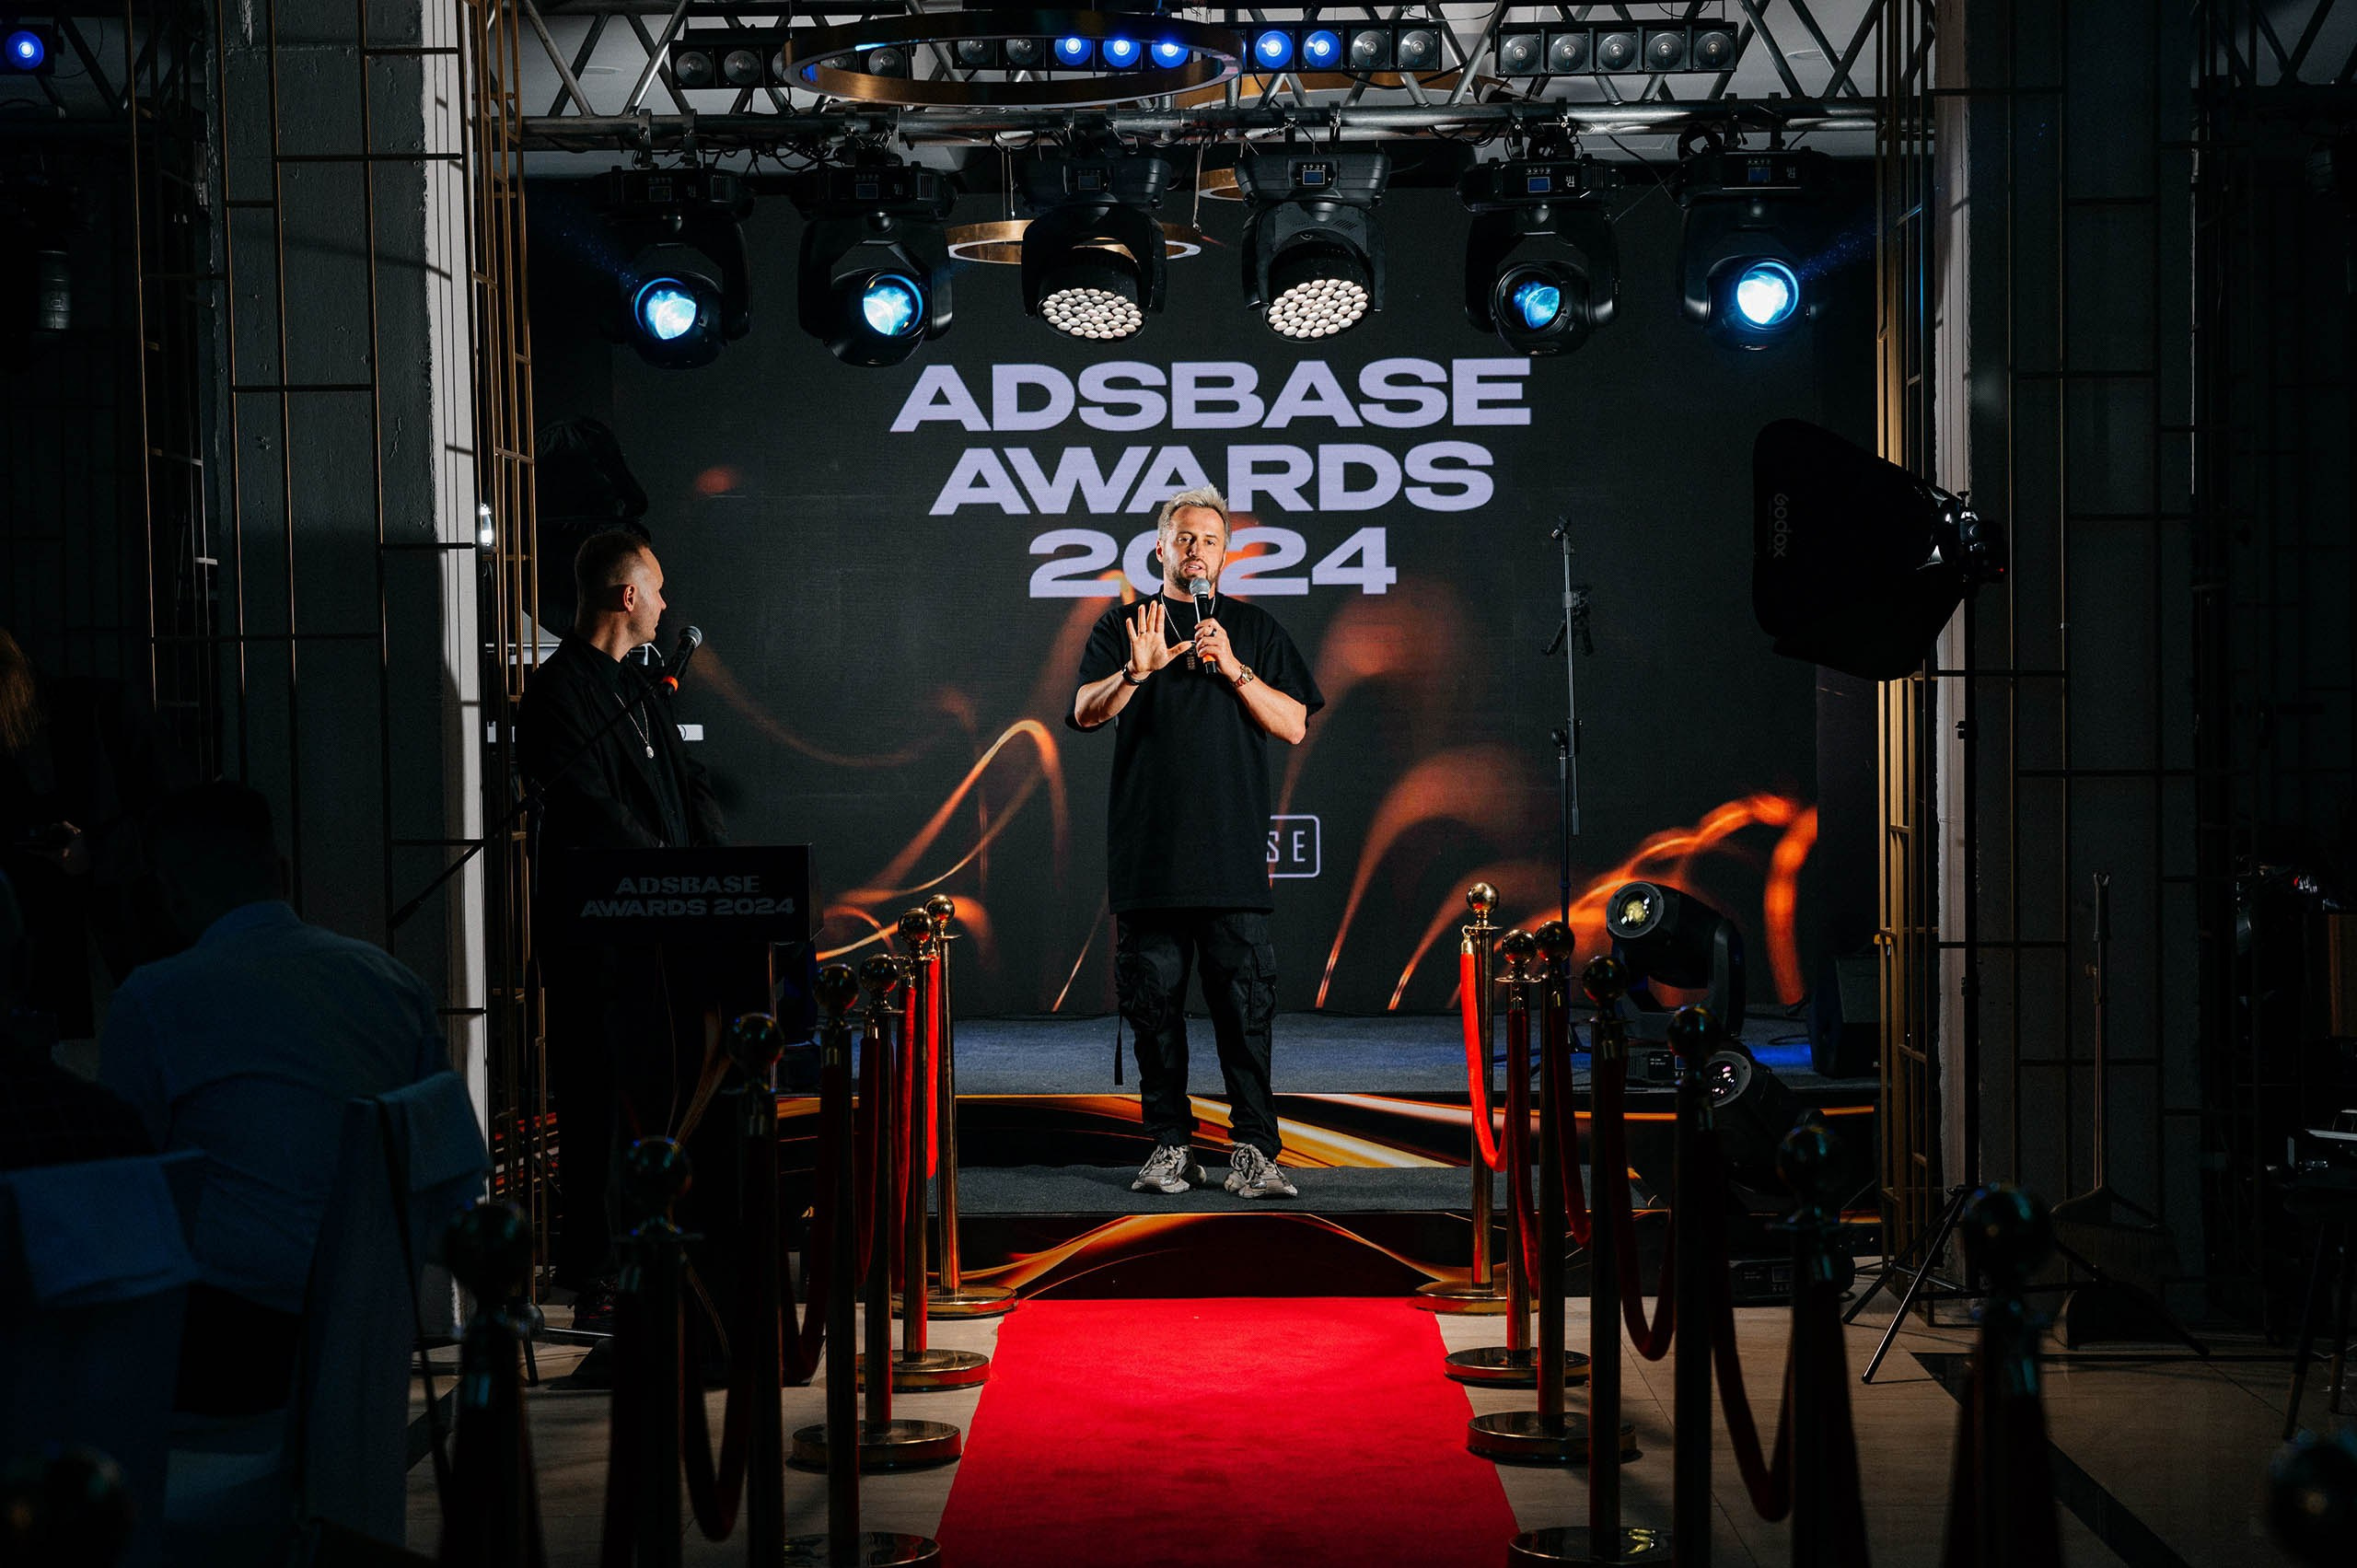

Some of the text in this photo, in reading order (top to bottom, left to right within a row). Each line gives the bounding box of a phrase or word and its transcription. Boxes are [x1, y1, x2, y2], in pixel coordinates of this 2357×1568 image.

[889, 358, 1531, 432] ADSBASE
[929, 441, 1494, 516] AWARDS
[580, 897, 796, 919] AWARDS 2024
[614, 876, 761, 896] ADSBASE
